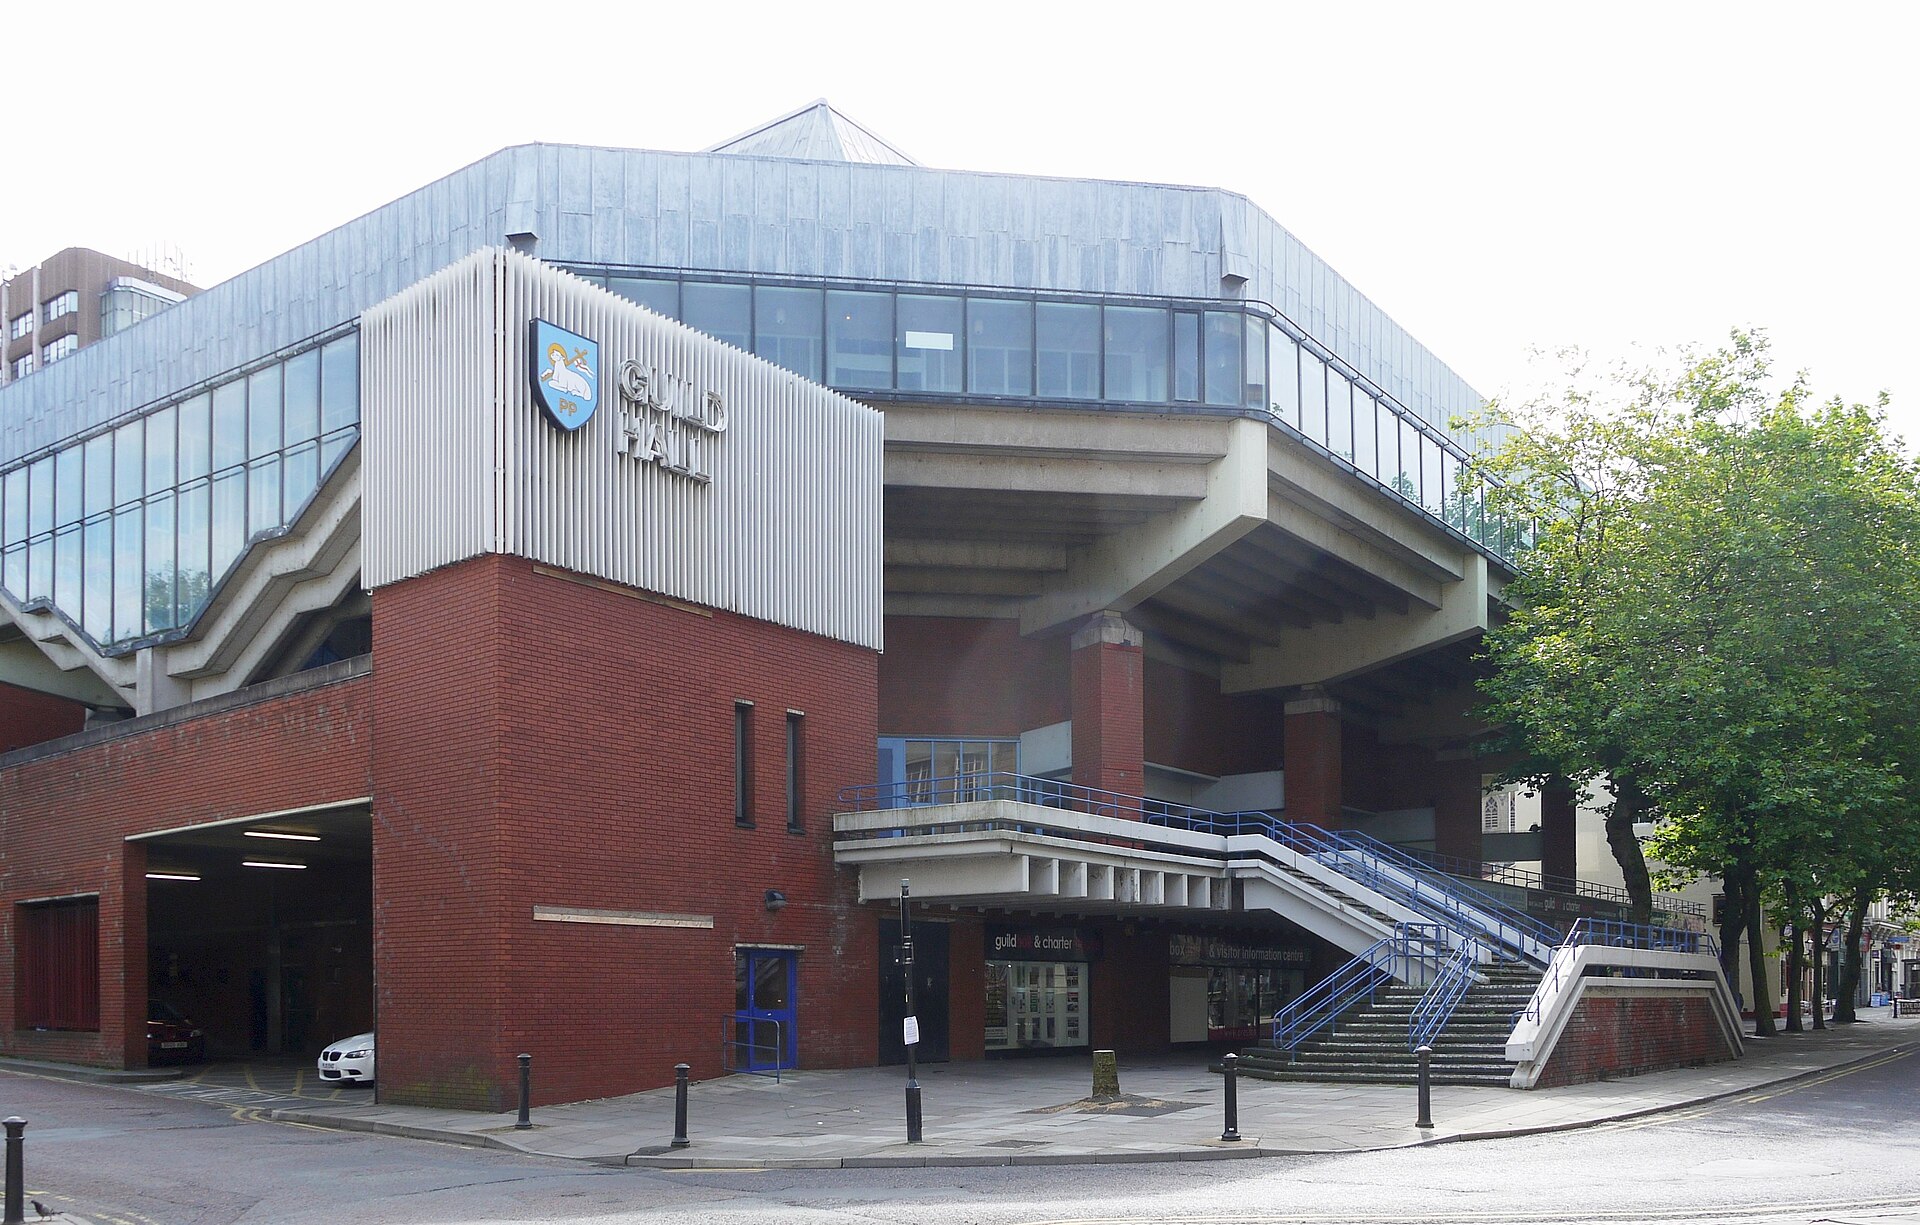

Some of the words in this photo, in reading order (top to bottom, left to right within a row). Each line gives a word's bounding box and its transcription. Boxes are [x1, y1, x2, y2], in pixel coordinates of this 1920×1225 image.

[617, 358, 729, 433] GUILD
[617, 411, 713, 485] HALL
[1034, 935, 1041, 949] &
[1042, 935, 1073, 949] charter
[1209, 944, 1215, 957] &
[1217, 944, 1240, 959] visitor
[1242, 945, 1282, 961] information
[1283, 949, 1304, 961] centre
